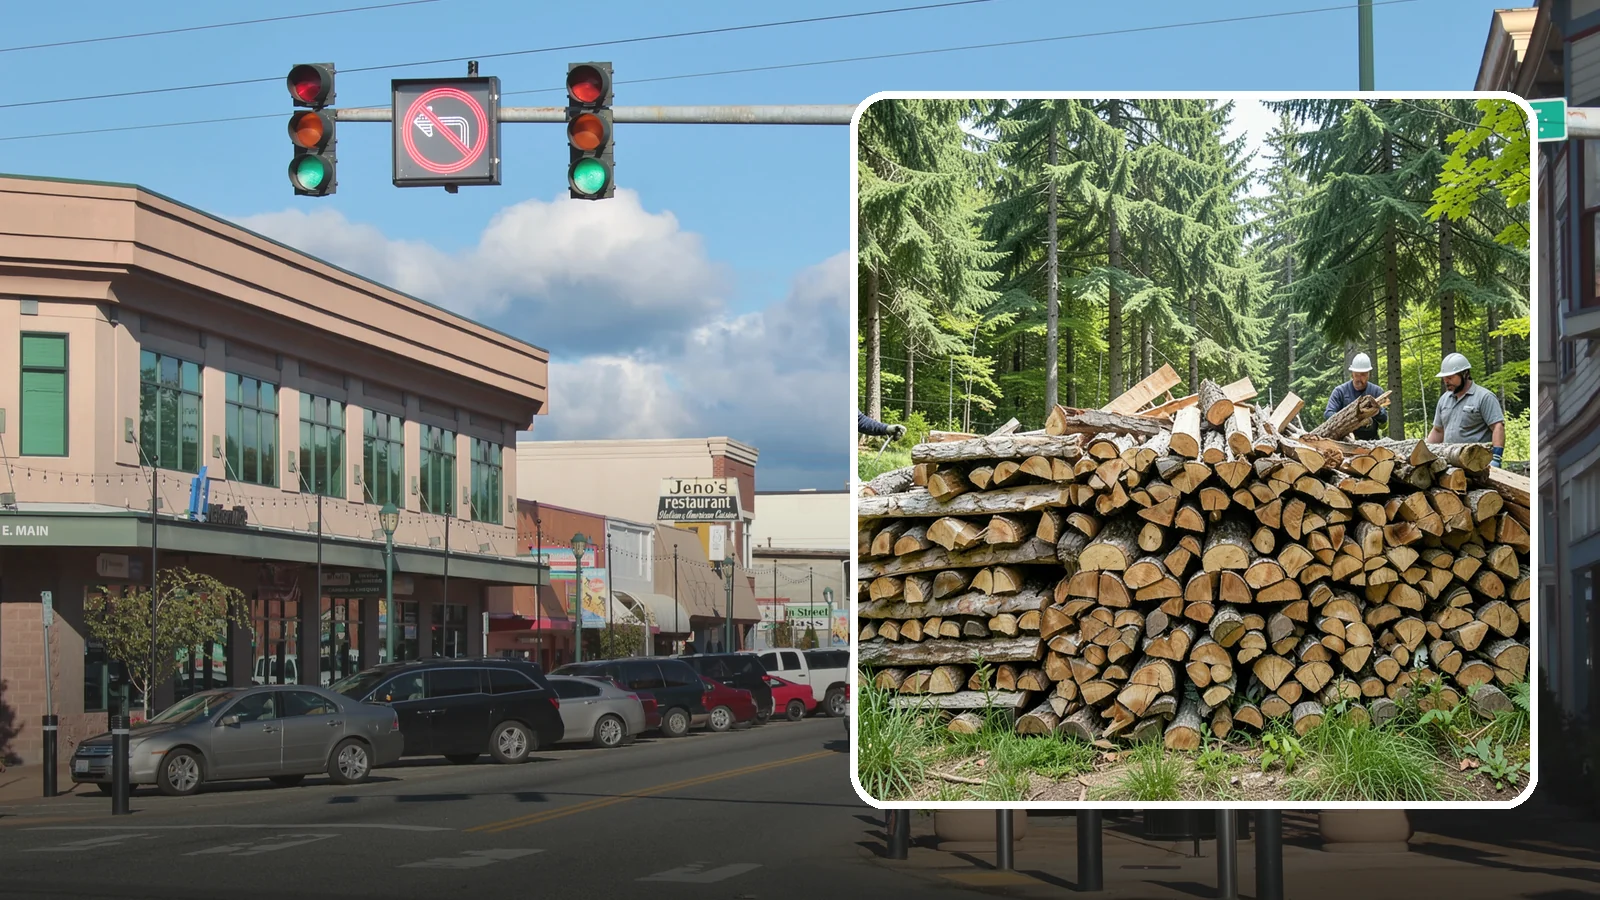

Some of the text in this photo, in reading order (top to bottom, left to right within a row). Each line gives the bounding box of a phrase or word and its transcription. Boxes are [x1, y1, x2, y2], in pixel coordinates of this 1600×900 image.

[669, 480, 727, 495] Jeno's
[665, 496, 731, 509] restaurant
[714, 509, 738, 519] Cuisine
[2, 525, 49, 536] E. MAIN
[797, 608, 828, 617] Street
[791, 619, 823, 627] lass
